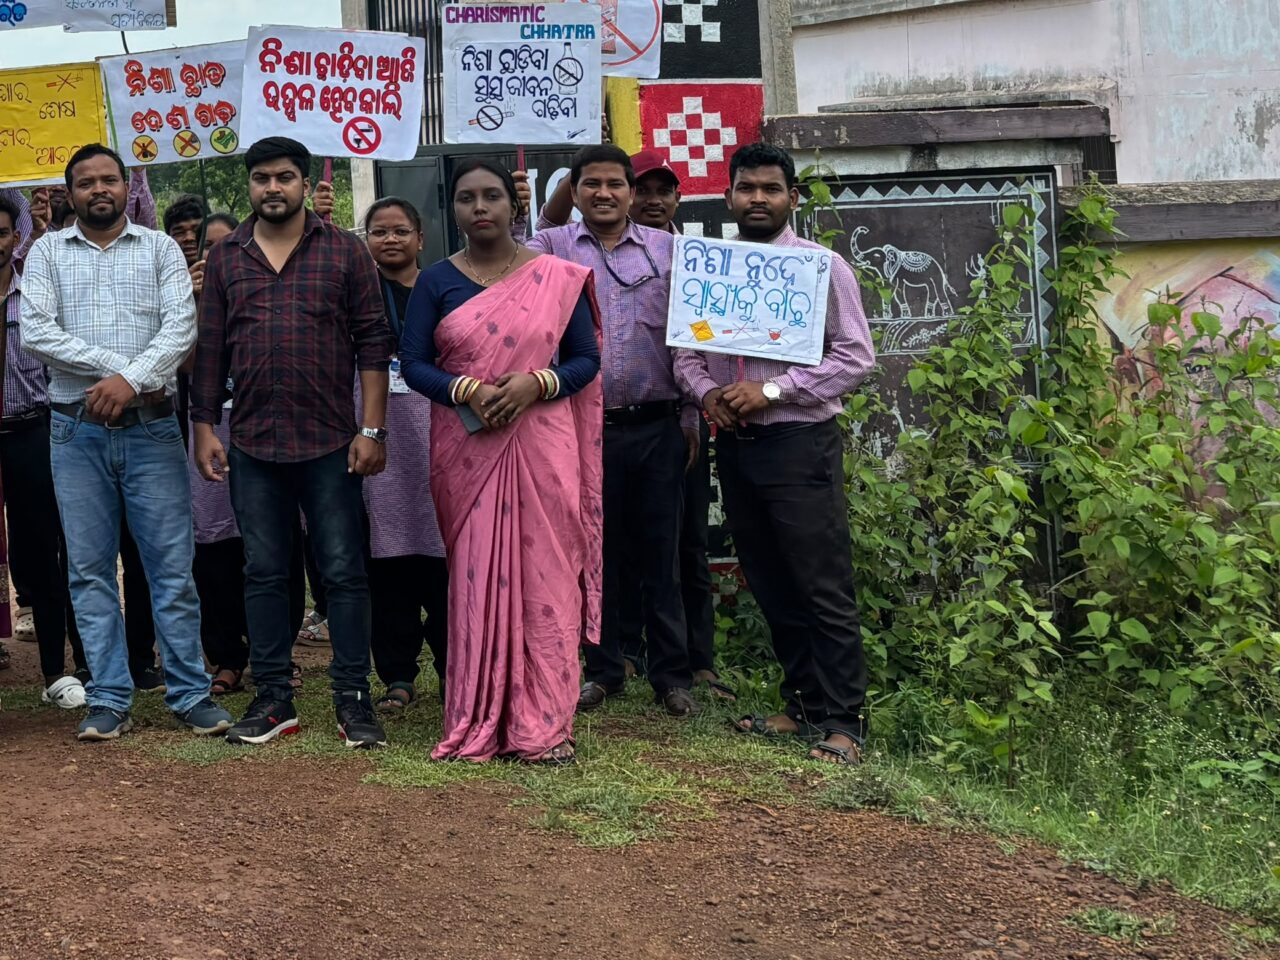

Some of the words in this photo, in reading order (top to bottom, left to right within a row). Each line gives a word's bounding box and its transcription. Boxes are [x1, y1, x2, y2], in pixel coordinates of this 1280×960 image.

[520, 24, 596, 40] CHHATRA
[258, 37, 312, 75] ନିଶା
[461, 44, 492, 71] ନିଶା
[124, 59, 177, 96] ନିଶା
[683, 239, 733, 277] ନିଶା
